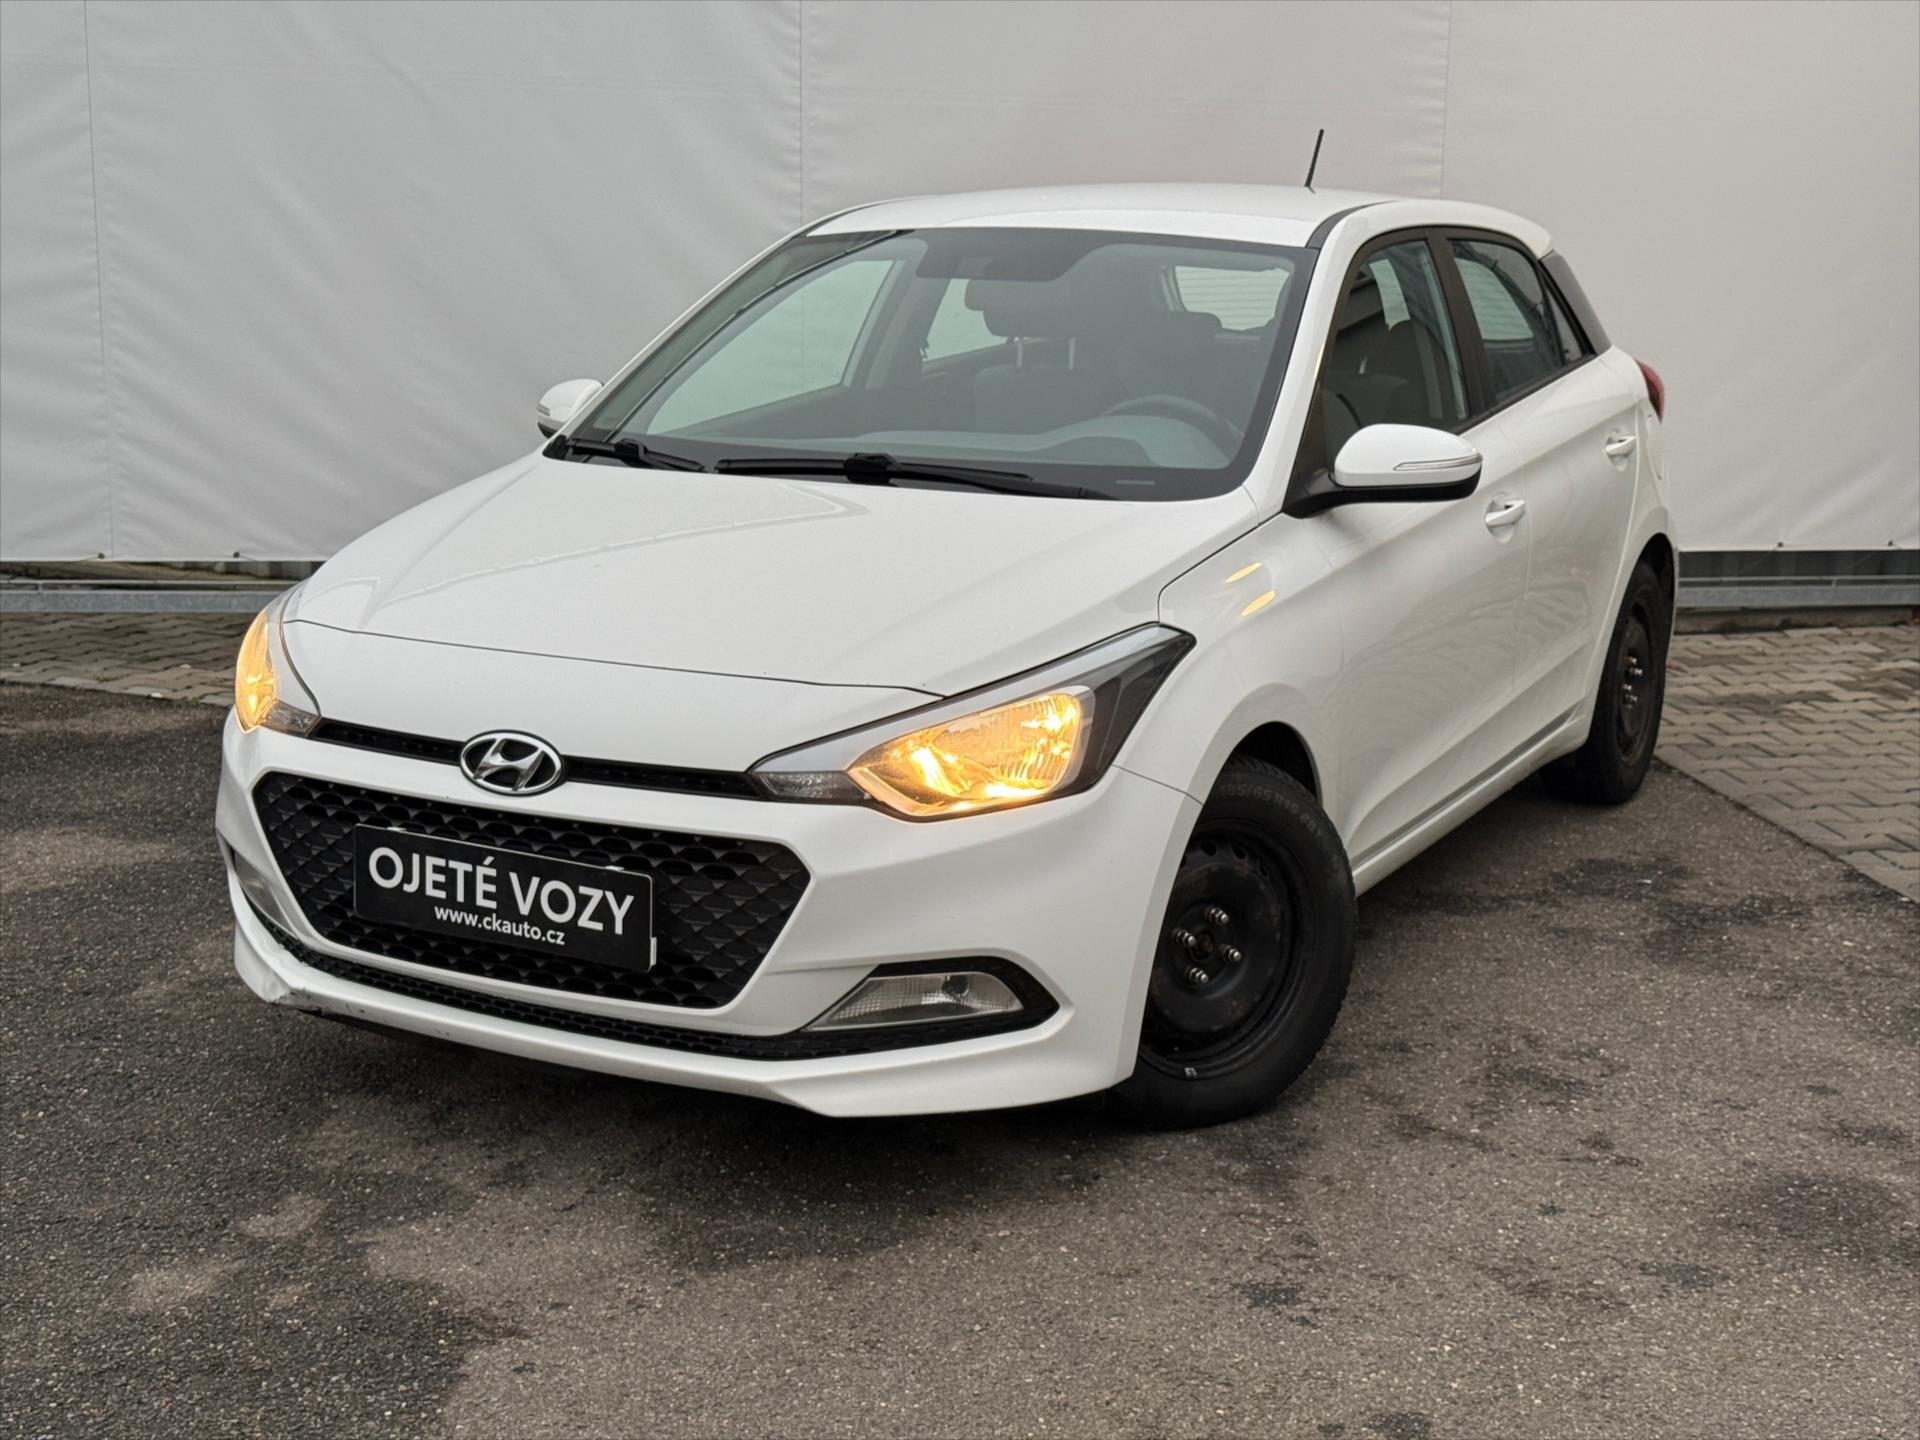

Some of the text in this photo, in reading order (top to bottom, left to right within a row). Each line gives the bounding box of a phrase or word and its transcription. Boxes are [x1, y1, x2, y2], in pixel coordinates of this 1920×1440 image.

[368, 846, 635, 936] OJETÉ VOZY
[433, 905, 566, 946] www.ckauto.cz
